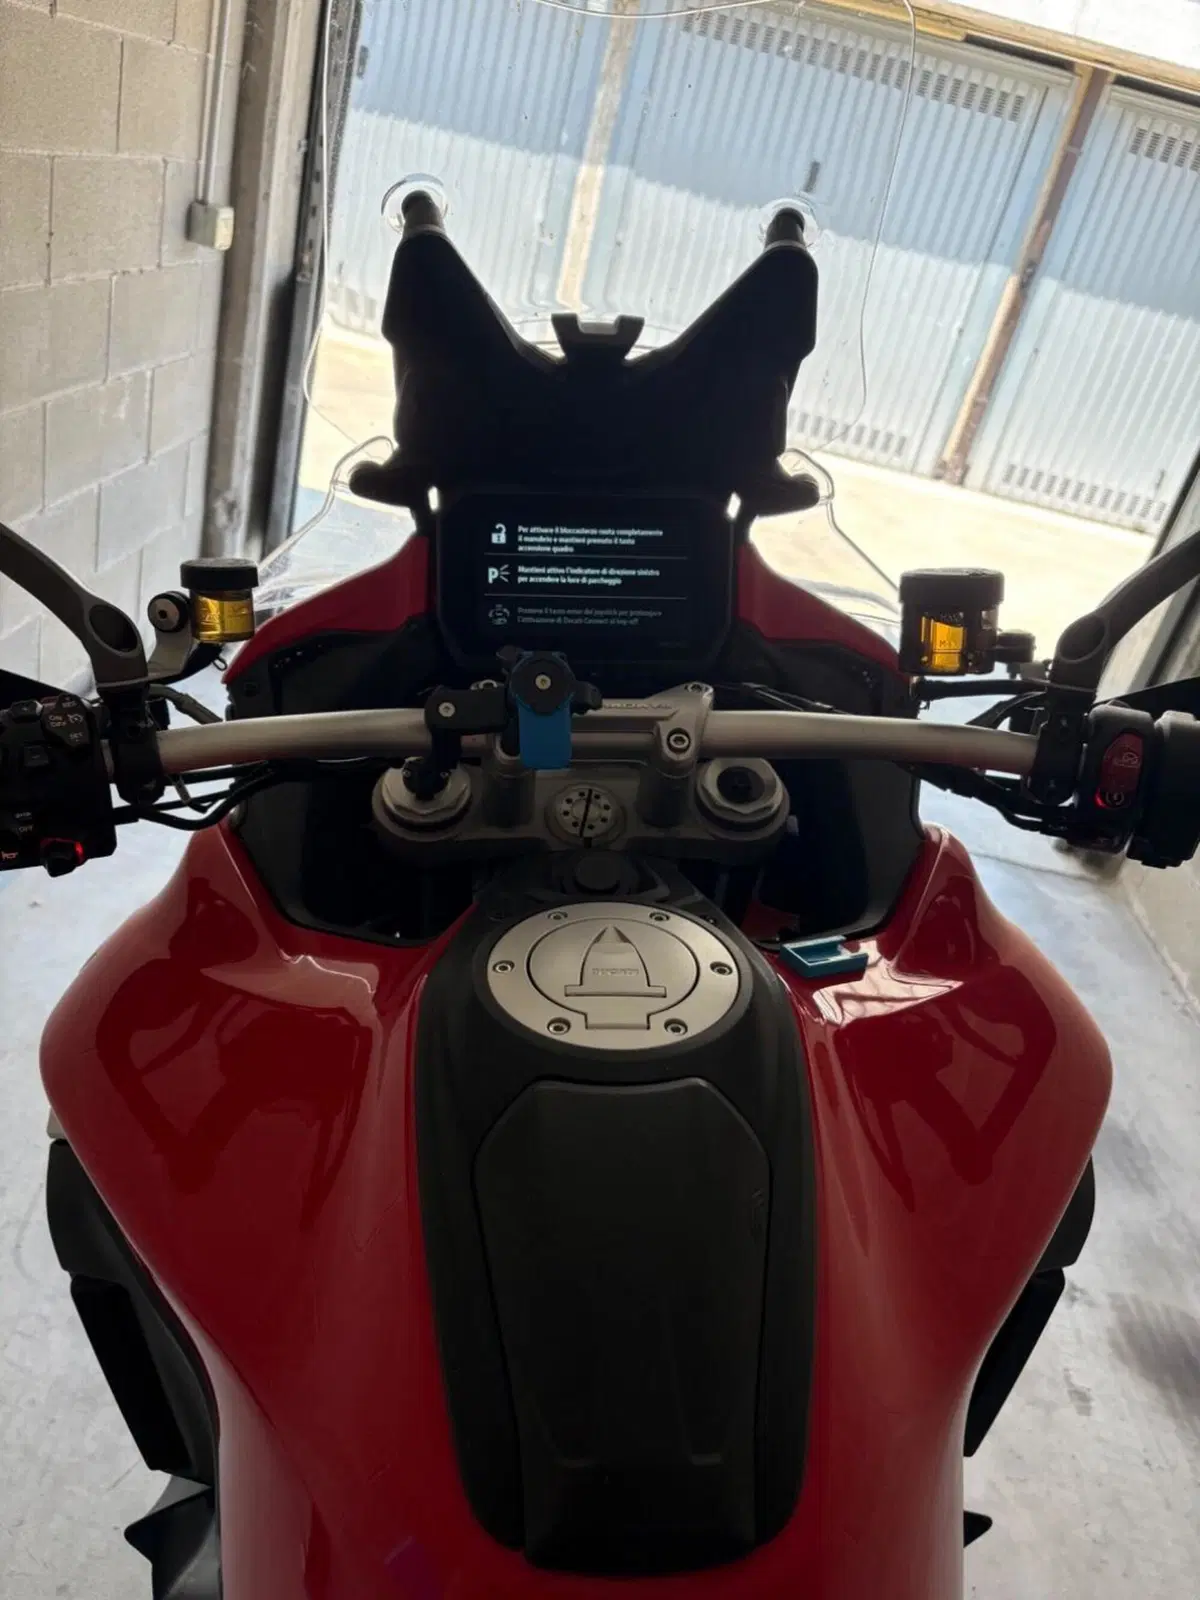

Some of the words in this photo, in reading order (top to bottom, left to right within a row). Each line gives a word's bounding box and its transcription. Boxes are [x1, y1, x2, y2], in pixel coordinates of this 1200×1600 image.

[518, 525, 528, 533] Per
[530, 526, 553, 534] attivare
[616, 528, 663, 537] completamente
[559, 536, 585, 544] mantieni
[586, 537, 612, 545] premuto
[518, 544, 551, 552] accensione
[552, 545, 574, 553] quadro
[518, 565, 546, 573] Mantieni
[547, 566, 565, 574] attivo
[518, 576, 528, 584] per
[588, 577, 622, 586] parcheggio
